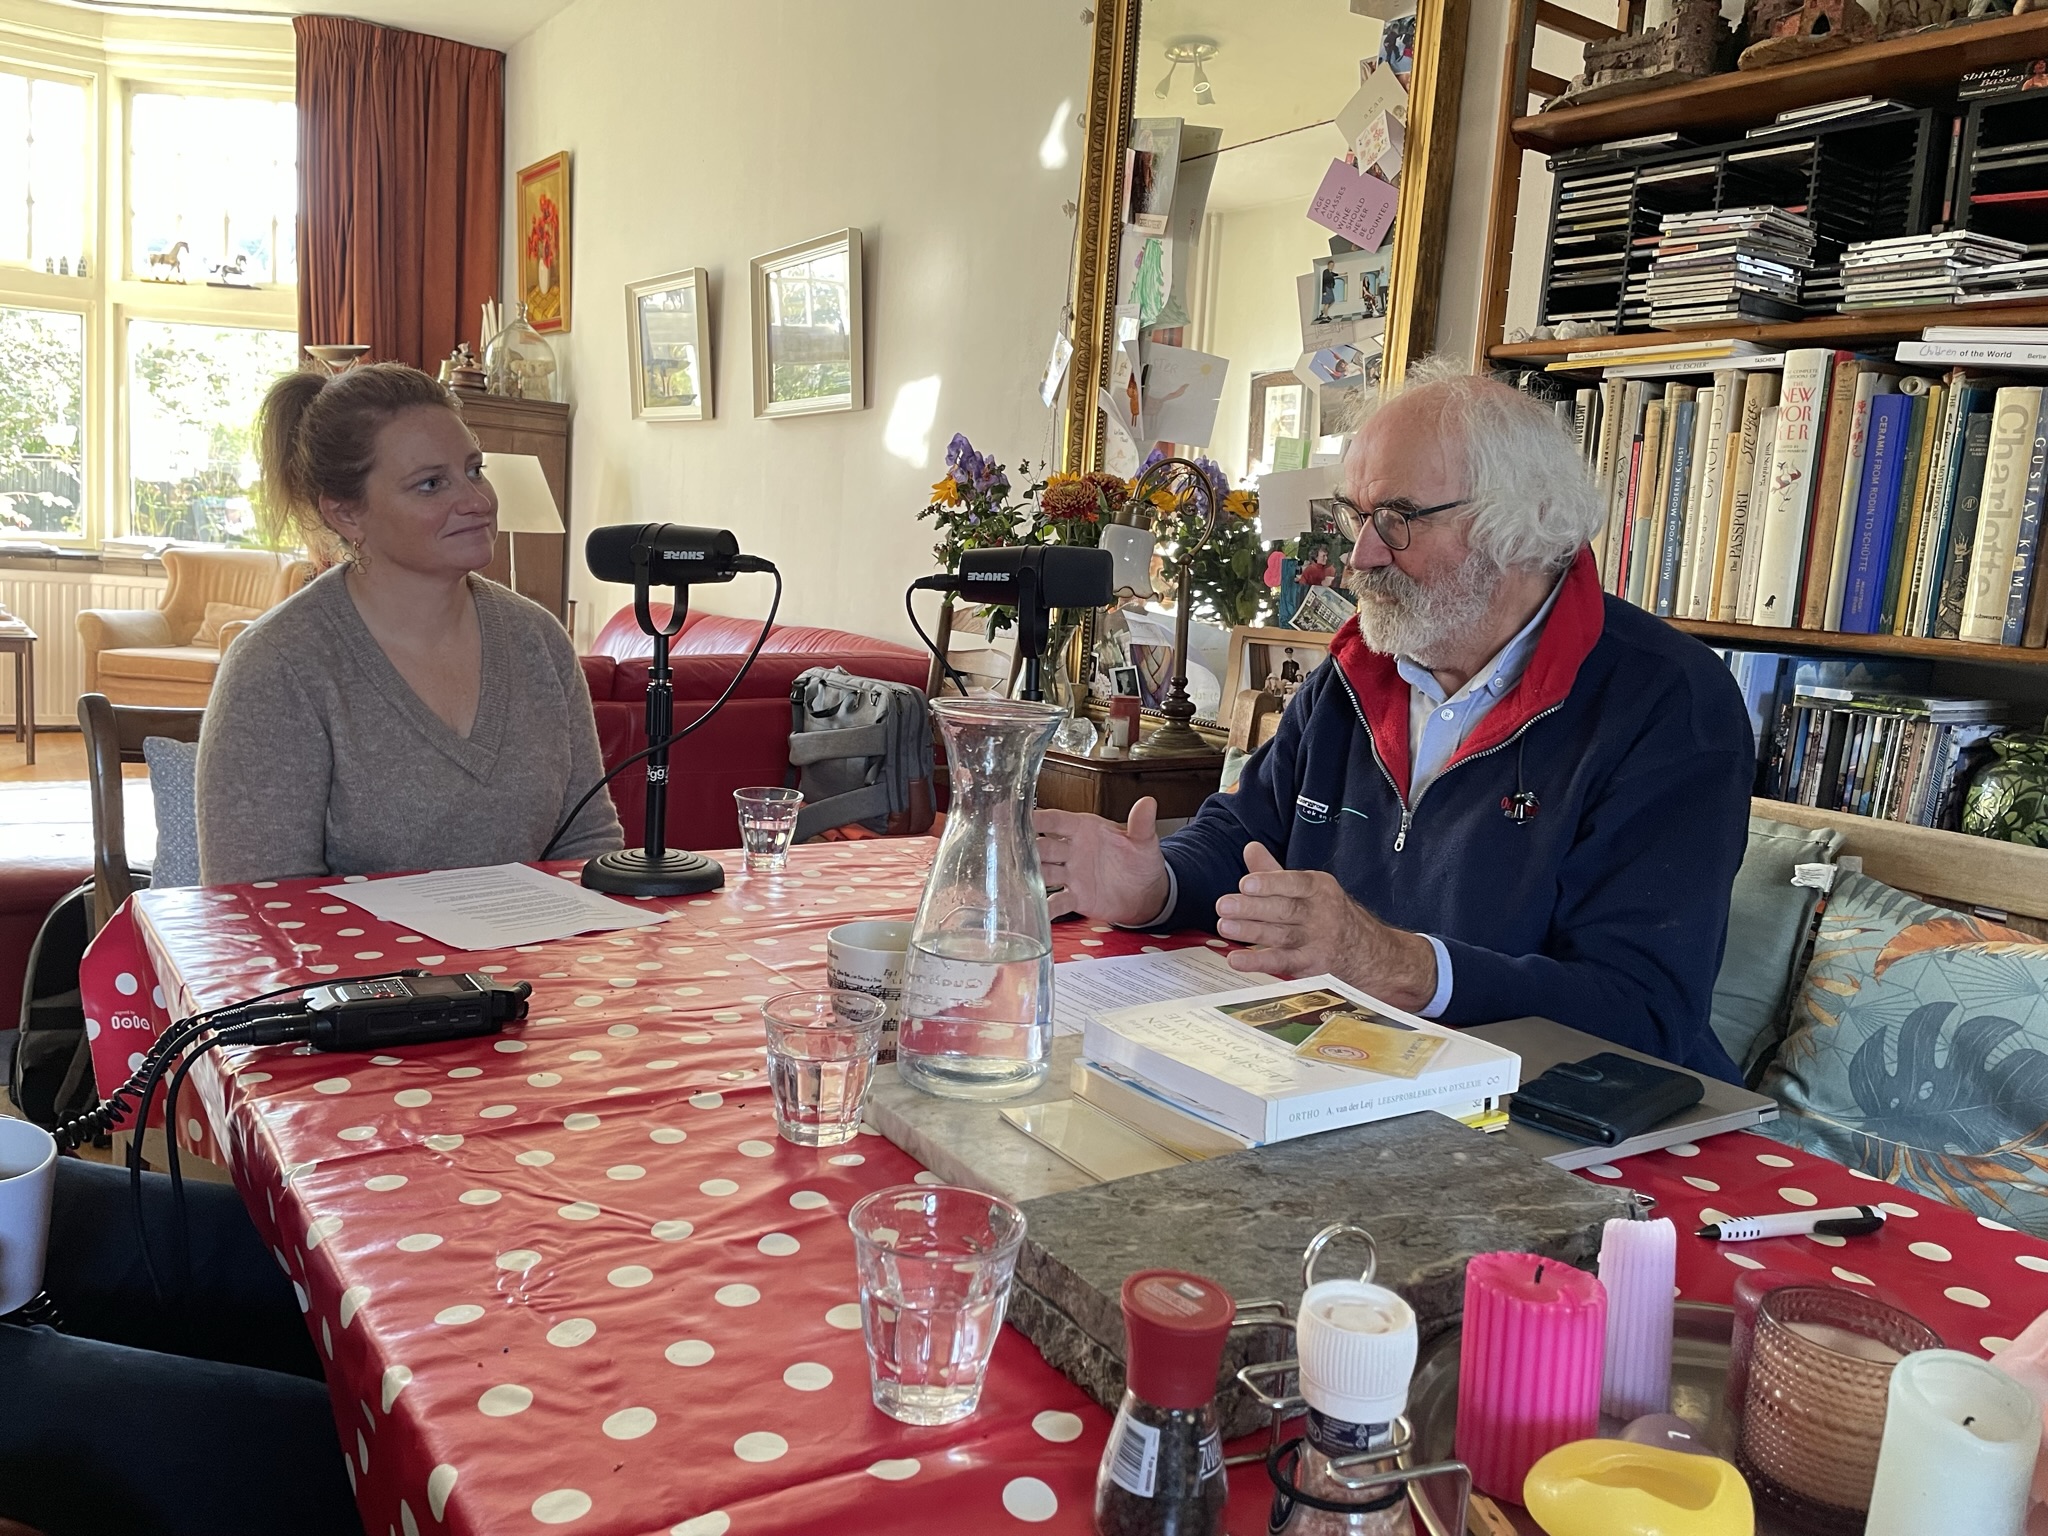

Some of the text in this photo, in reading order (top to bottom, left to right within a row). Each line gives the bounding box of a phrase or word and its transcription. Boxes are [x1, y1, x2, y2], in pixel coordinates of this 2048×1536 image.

[1961, 68, 2010, 82] Shirley
[1980, 74, 2027, 87] Bassey
[1314, 196, 1325, 212] AGE
[1321, 198, 1331, 217] AND
[1327, 186, 1346, 220] GLASSES
[1345, 197, 1365, 230] SHOULD
[1333, 212, 1341, 223] OF
[1337, 206, 1352, 230] WINE
[1352, 208, 1369, 234] NEVER
[1366, 202, 1389, 240] COUNTED
[1359, 226, 1368, 237] BE
[1919, 344, 1957, 357] Children
[1971, 350, 1984, 358] the
[1987, 350, 2013, 358] World
[1712, 384, 1726, 430] ECCE
[1783, 387, 1816, 404] NEW
[1949, 394, 1957, 408] THE
[1779, 405, 1812, 422] YOR
[1875, 415, 1888, 457] CERAMIX
[1702, 438, 1719, 499] HOMO
[1759, 457, 1771, 487] Steinberg
[1872, 459, 1882, 485] FROM
[1936, 464, 1946, 494] MOTHER
[2023, 437, 2047, 523] GUSTAV
[1663, 446, 1685, 580] MUSEUM VOOR MODERNE KUNST
[1867, 488, 1878, 516] RODIN
[1978, 404, 2029, 598] Charlotte
[1729, 490, 1749, 559] PASSPORT
[1865, 518, 1873, 529] TO
[663, 550, 705, 560] SHURE
[1730, 561, 1738, 572] The
[967, 572, 1010, 582] SHURE
[111, 1015, 150, 1030] lola
[1165, 1011, 1250, 1054] DYSLEXIE
[1143, 1016, 1294, 1084] LEESPROBLEMEN
[1252, 1050, 1278, 1065] EN
[1288, 1080, 1482, 1123] ORTHO A. van der Leij LEESPROBLEMEN EN DYSLEXIE
